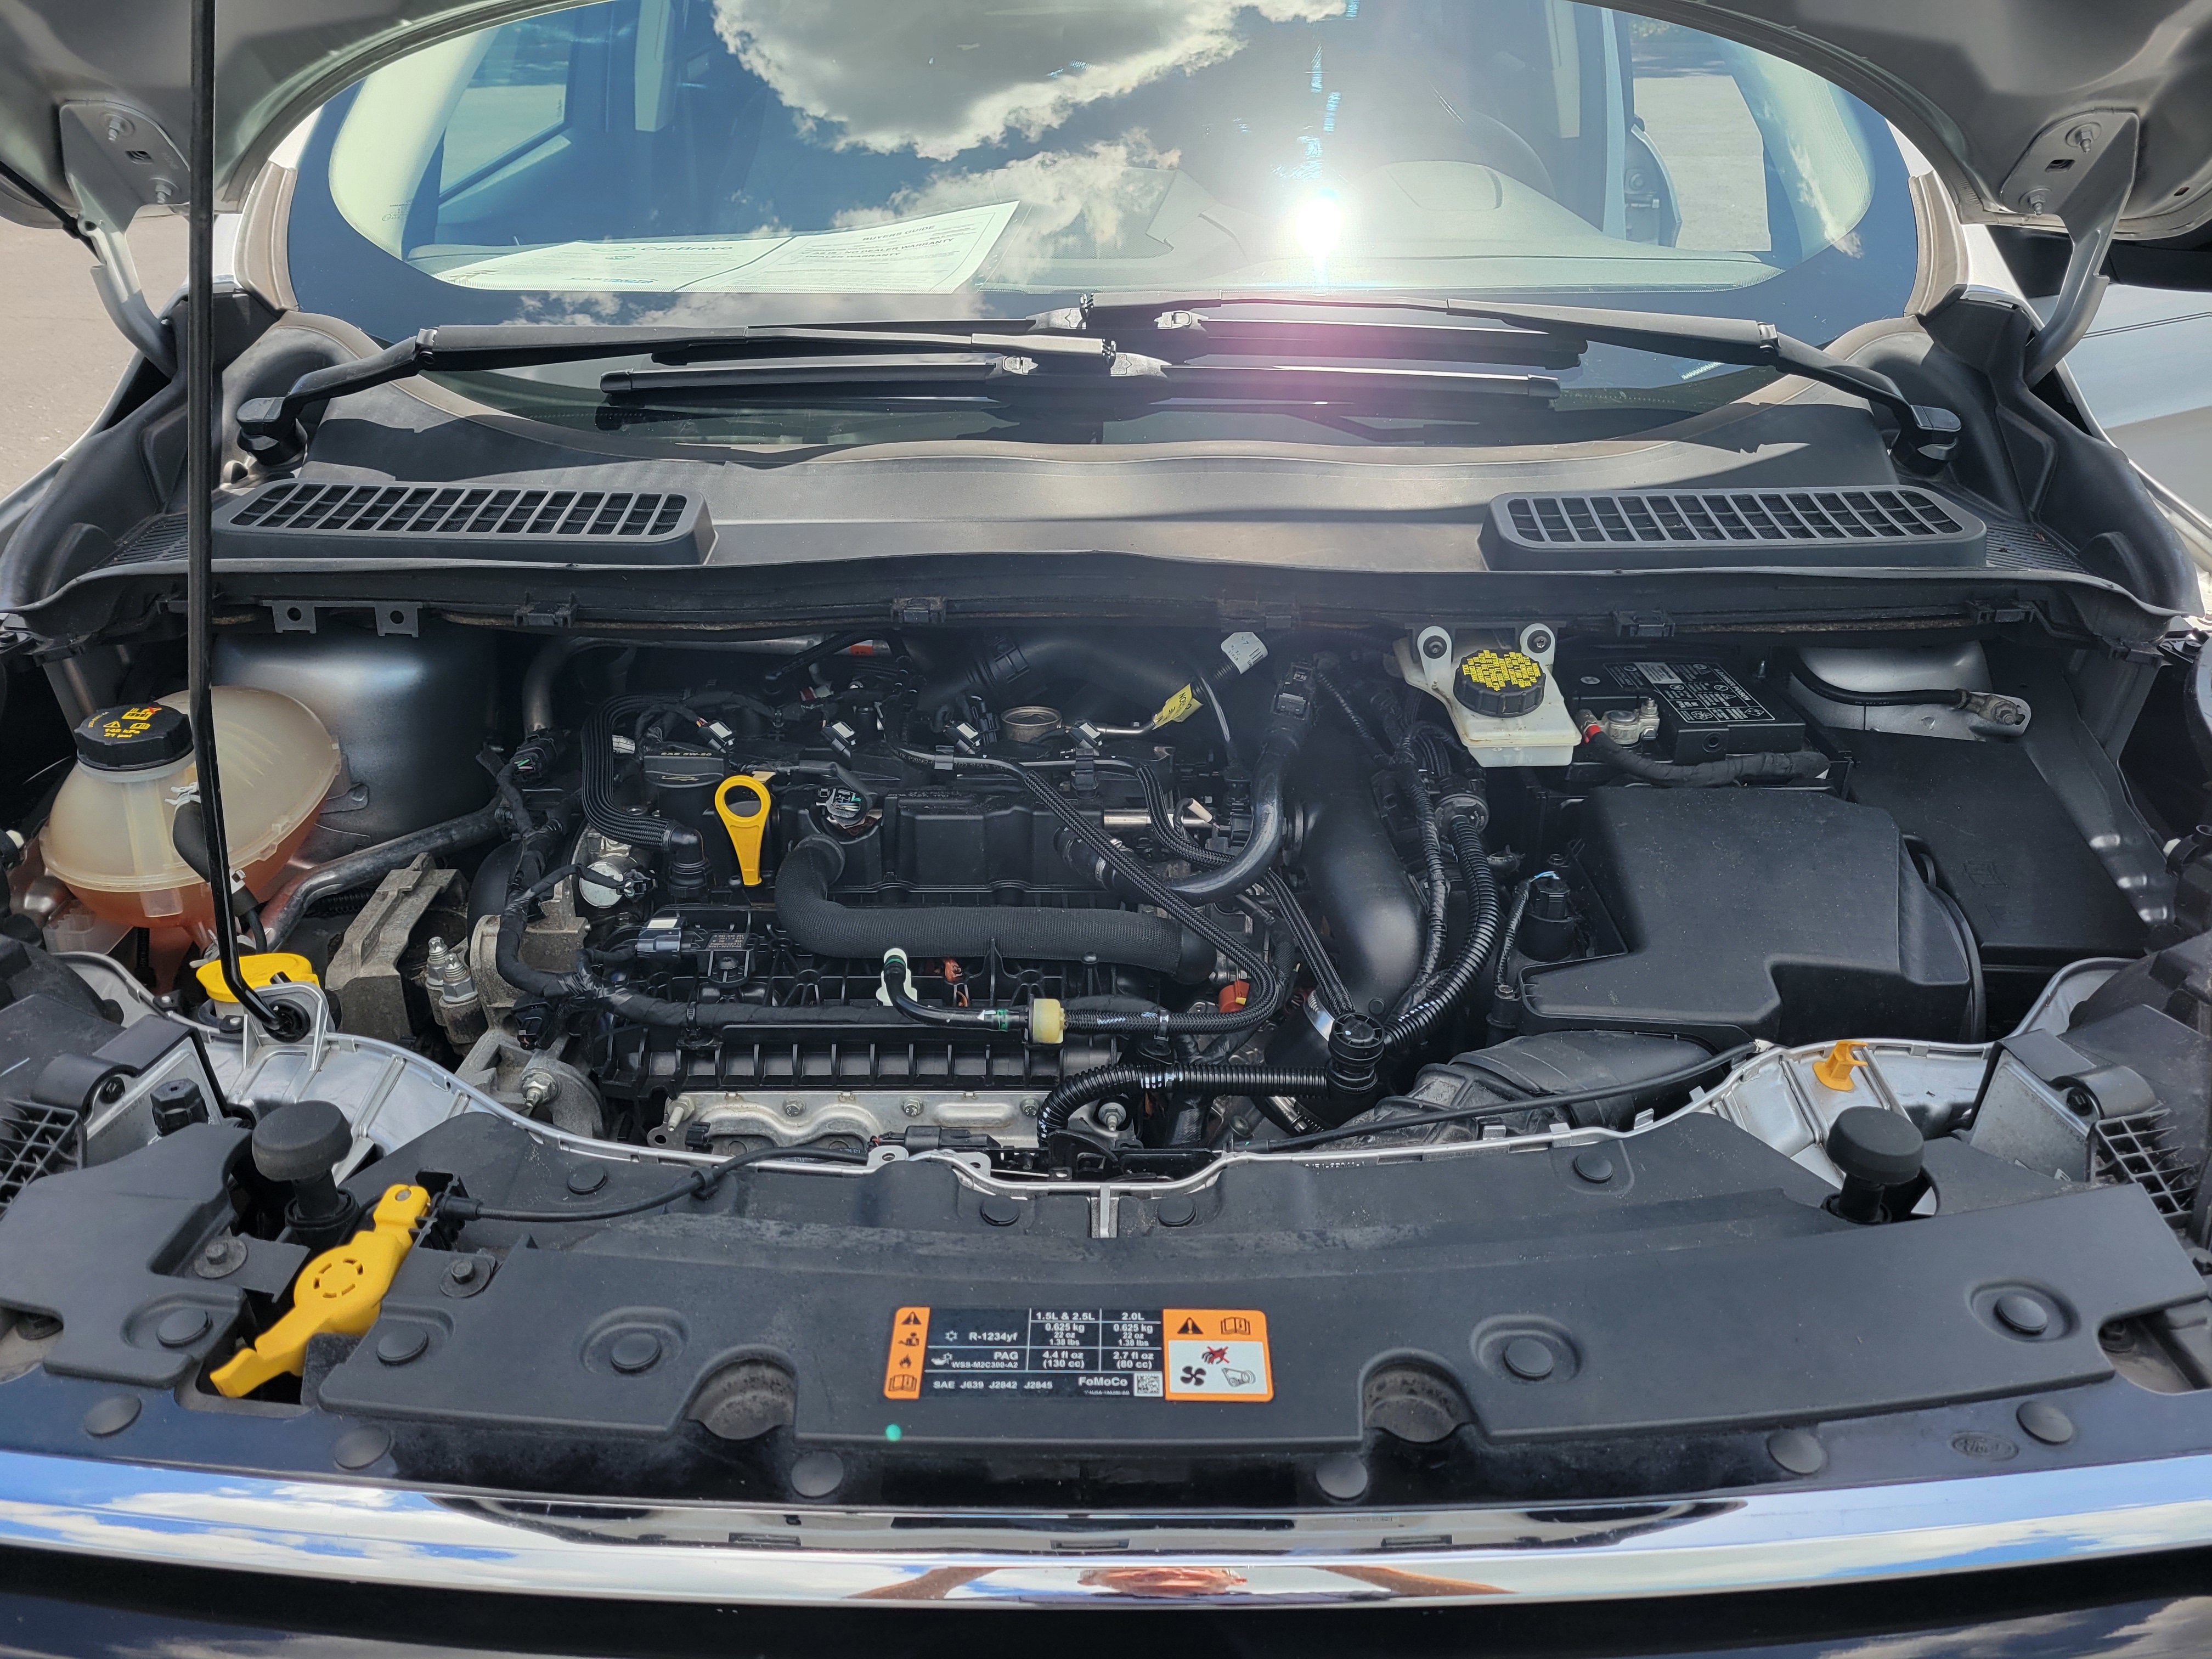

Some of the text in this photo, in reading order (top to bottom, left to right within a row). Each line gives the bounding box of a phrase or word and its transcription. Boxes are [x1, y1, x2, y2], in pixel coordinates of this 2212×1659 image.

[905, 225, 935, 234] GUIDE
[901, 238, 955, 250] WARRANTY
[1717, 671, 1736, 686] DANGER
[1732, 686, 1751, 701] POISON
[1036, 1312, 1058, 1320] 1.5L
[1072, 1312, 1095, 1321] 2.5L
[1121, 1312, 1145, 1321] 2.0L
[1045, 1323, 1085, 1333] 0.625 kg
[1113, 1323, 1153, 1334] 0.625 kg
[968, 1331, 1018, 1342] R-1234yf
[994, 1351, 1019, 1360] PAG
[1042, 1351, 1059, 1359] 4.4
[1060, 1351, 1069, 1359] fl
[1113, 1351, 1129, 1359] 2.7
[1131, 1351, 1139, 1359] fl
[1042, 1359, 1085, 1369] (130 cc)
[1116, 1359, 1152, 1370] (80 cc)
[933, 1381, 955, 1389] SAE
[988, 1381, 1018, 1389] J2842
[1023, 1381, 1053, 1389] J2845
[1078, 1377, 1128, 1387] FoMoCo
